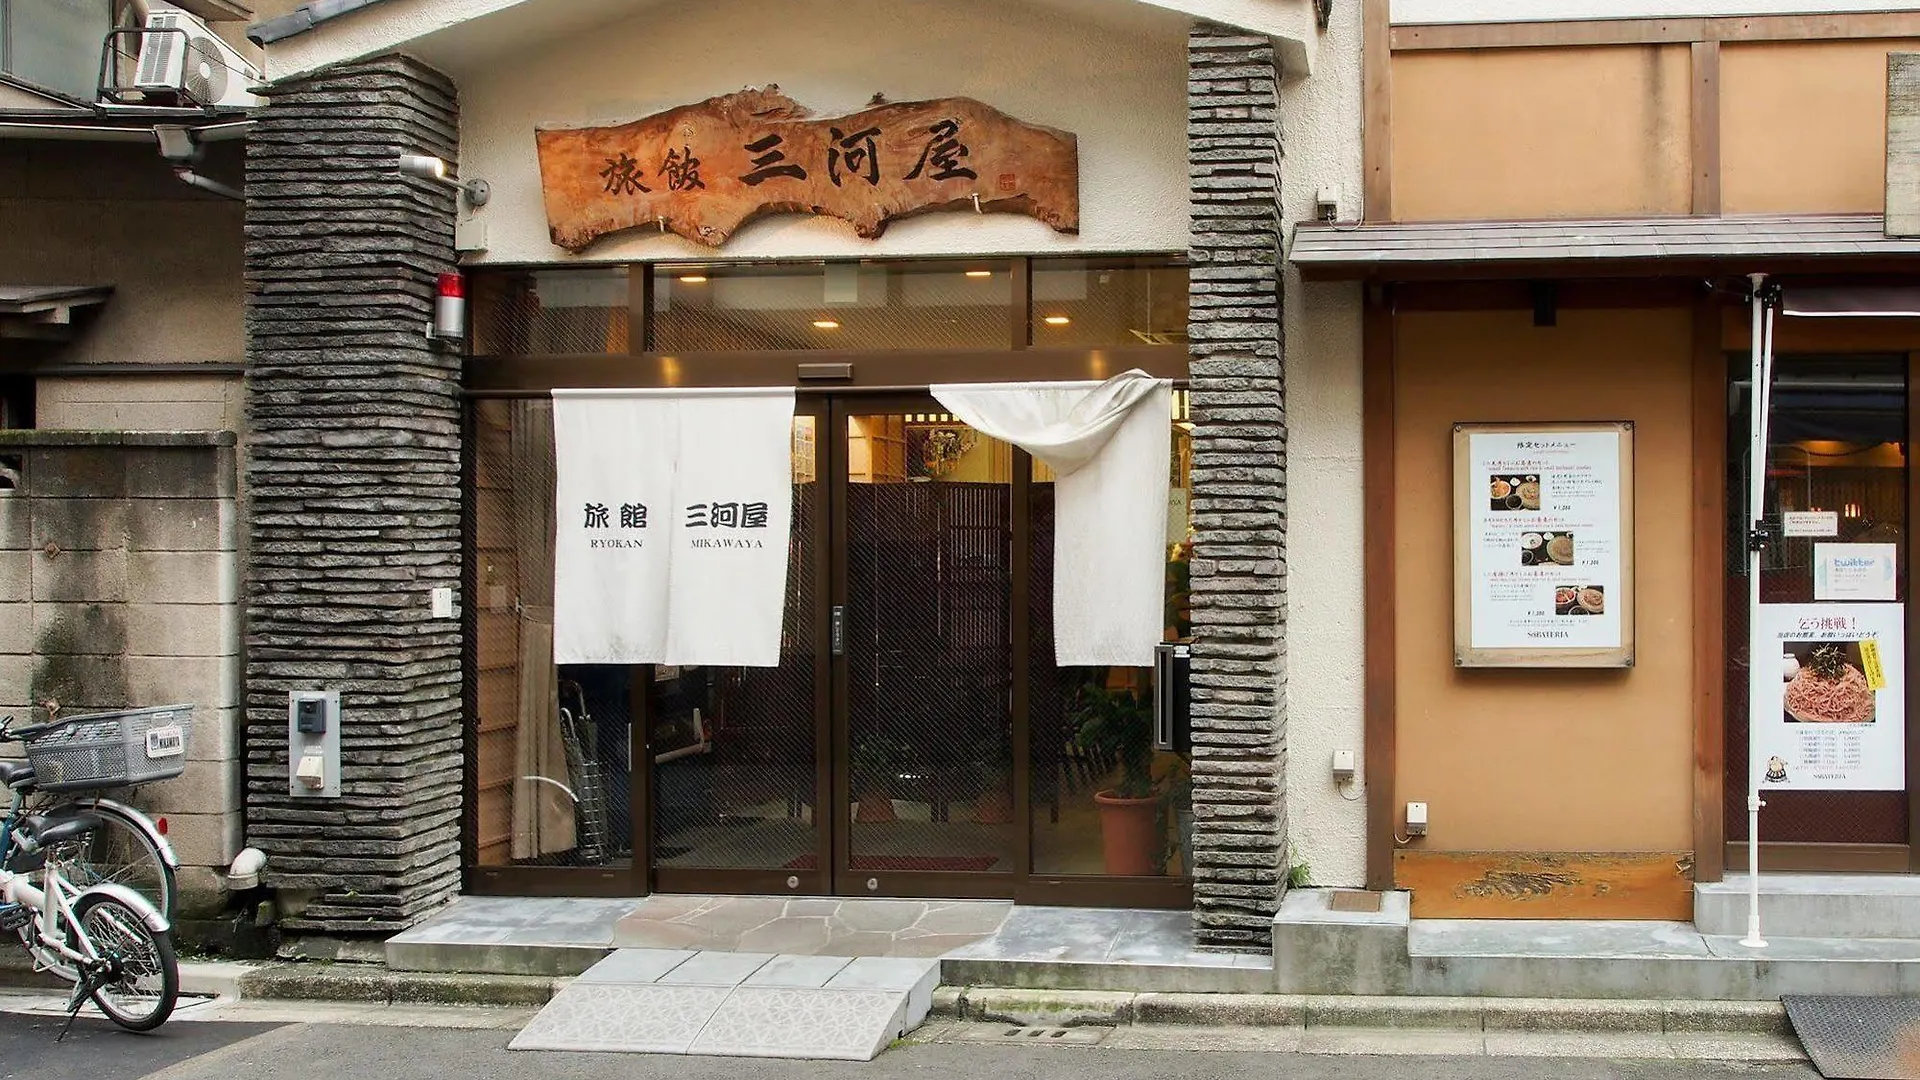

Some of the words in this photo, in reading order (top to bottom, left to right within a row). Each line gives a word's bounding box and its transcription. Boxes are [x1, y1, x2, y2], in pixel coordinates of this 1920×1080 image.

[738, 120, 978, 187] 三河屋
[584, 503, 648, 528] 旅館
[685, 502, 768, 528] 三河屋
[590, 539, 643, 548] RYOKAN
[691, 539, 763, 548] MIKAWAYA
